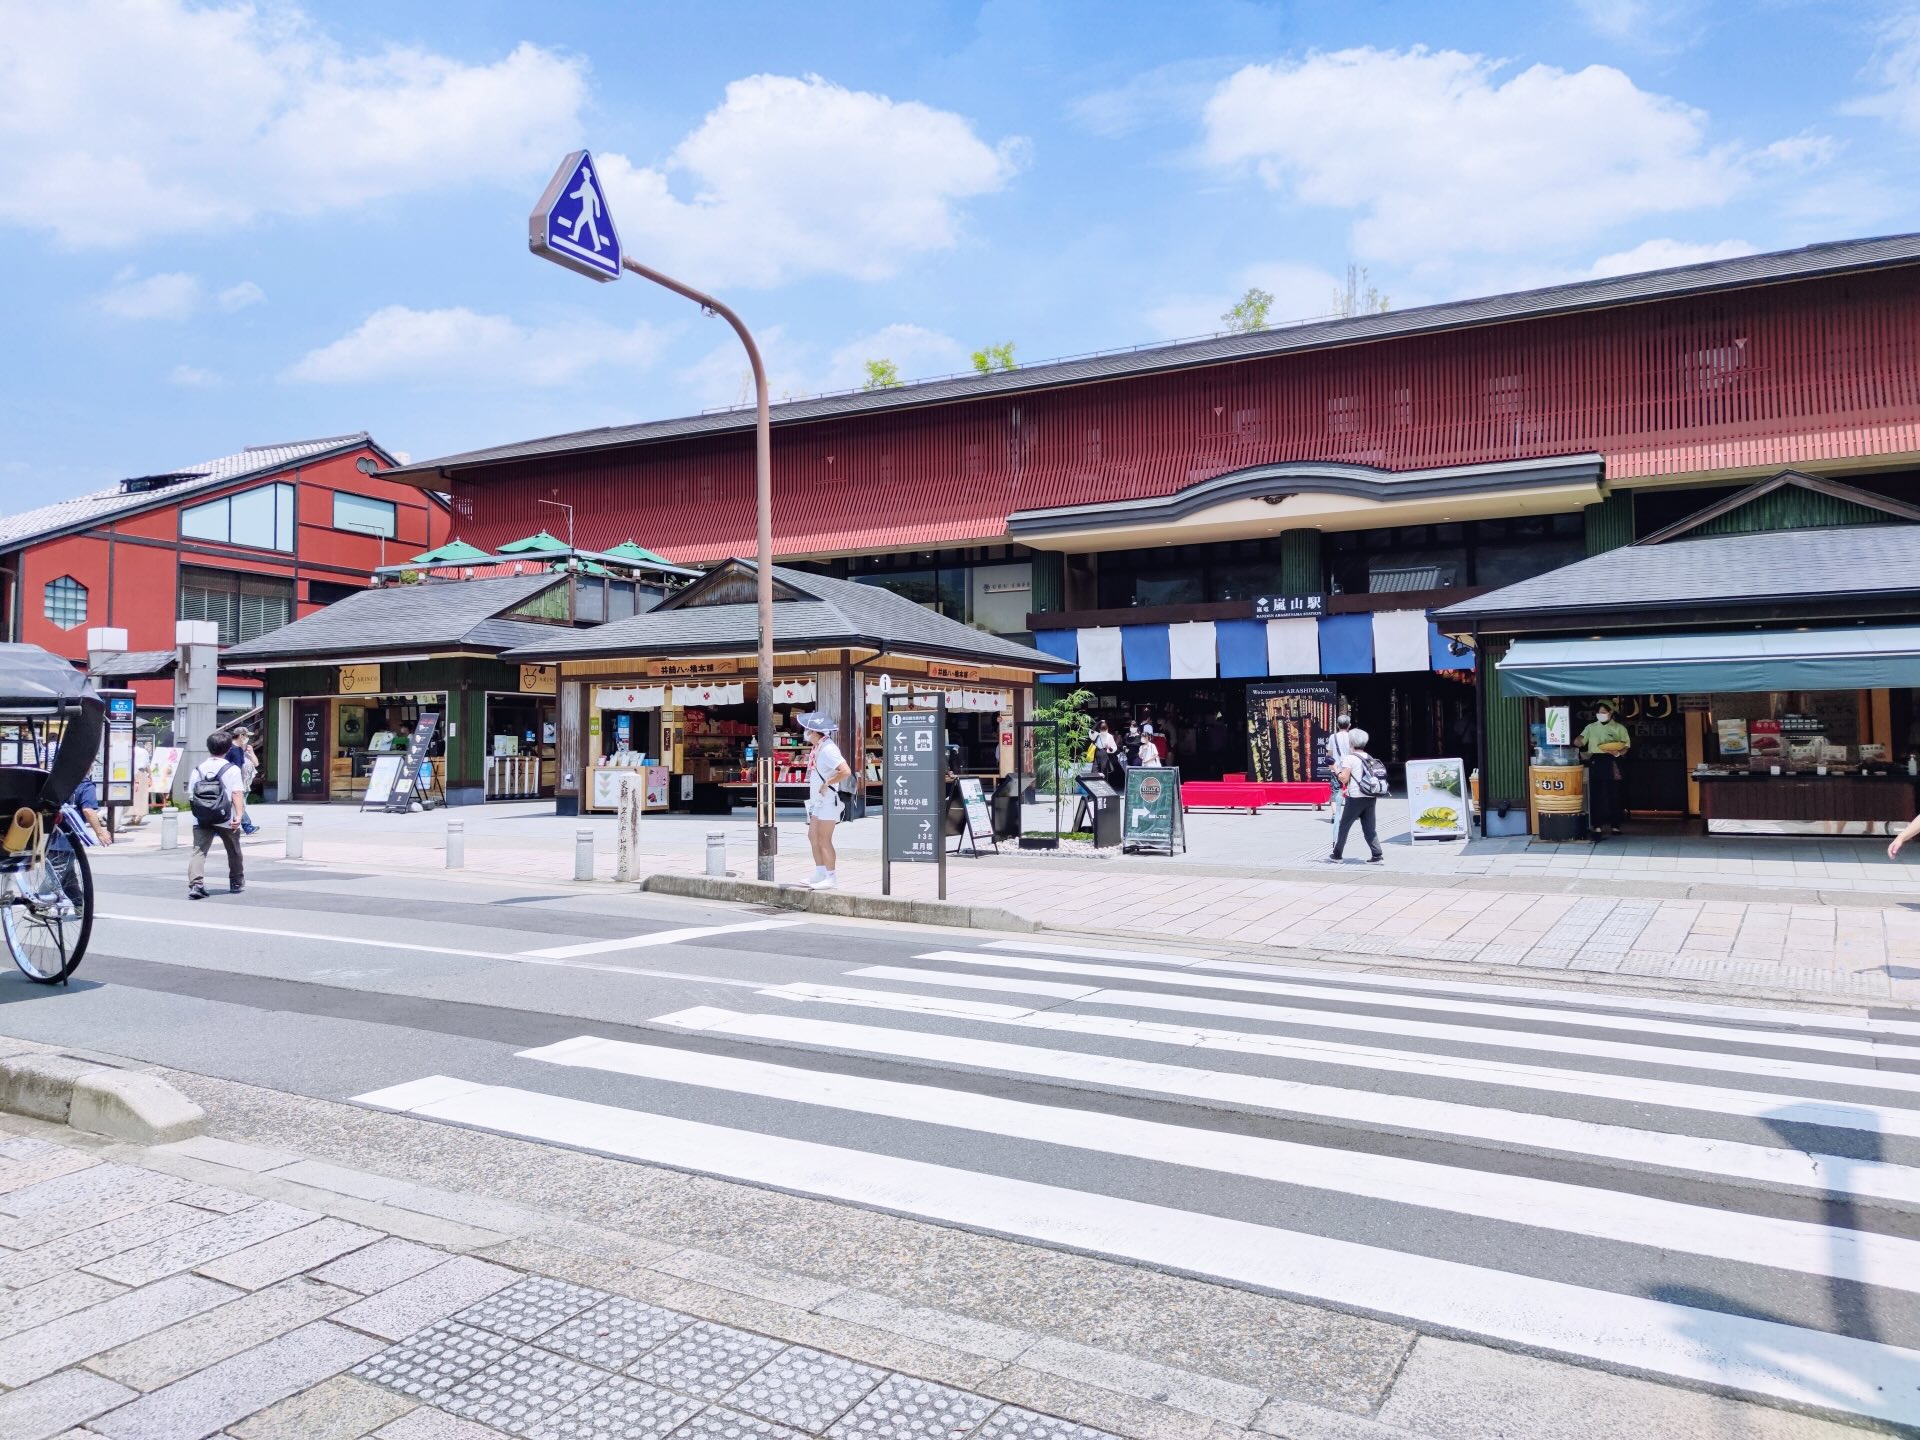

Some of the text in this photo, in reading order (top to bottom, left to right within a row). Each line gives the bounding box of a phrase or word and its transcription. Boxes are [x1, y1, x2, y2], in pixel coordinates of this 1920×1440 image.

[1273, 596, 1322, 612] 嵐山駅
[1317, 737, 1326, 765] 嵐山駅
[1543, 780, 1563, 790] もり
[894, 798, 928, 806] 竹林の小径
[912, 842, 932, 850] 渡月橋
